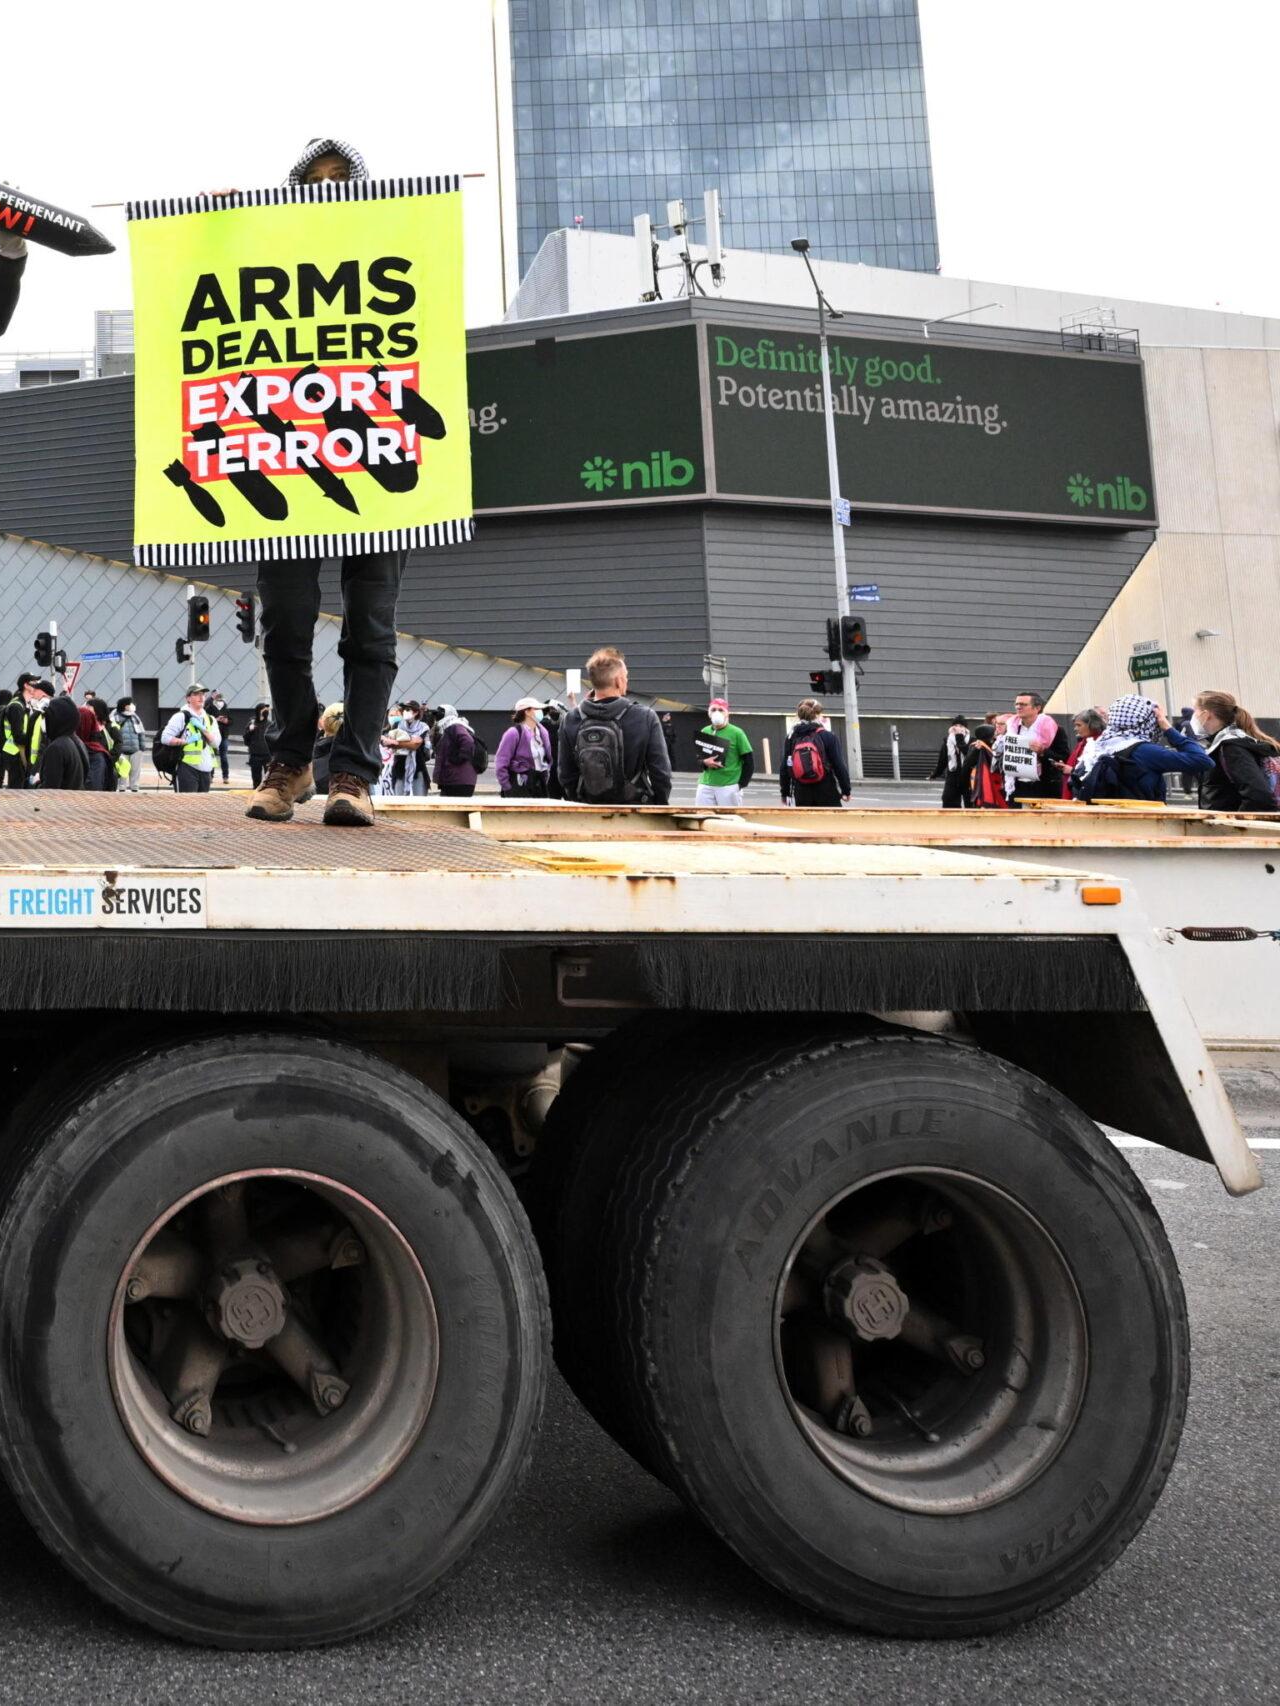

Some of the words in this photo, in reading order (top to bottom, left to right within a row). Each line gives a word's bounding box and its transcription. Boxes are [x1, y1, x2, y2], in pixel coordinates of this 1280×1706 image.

[181, 256, 417, 332] ARMS
[181, 322, 419, 375] DEALERS
[865, 354, 943, 387] good.
[188, 369, 415, 425] EXPORT
[717, 376, 876, 425] Potentially
[880, 395, 1008, 435] amazing.
[187, 424, 417, 478] TERROR!
[623, 450, 695, 490] nib
[1096, 475, 1147, 512] nib
[8, 887, 95, 916] FREIGHT
[101, 886, 202, 915] SERVICES
[733, 1107, 947, 1282] ADVANCE
